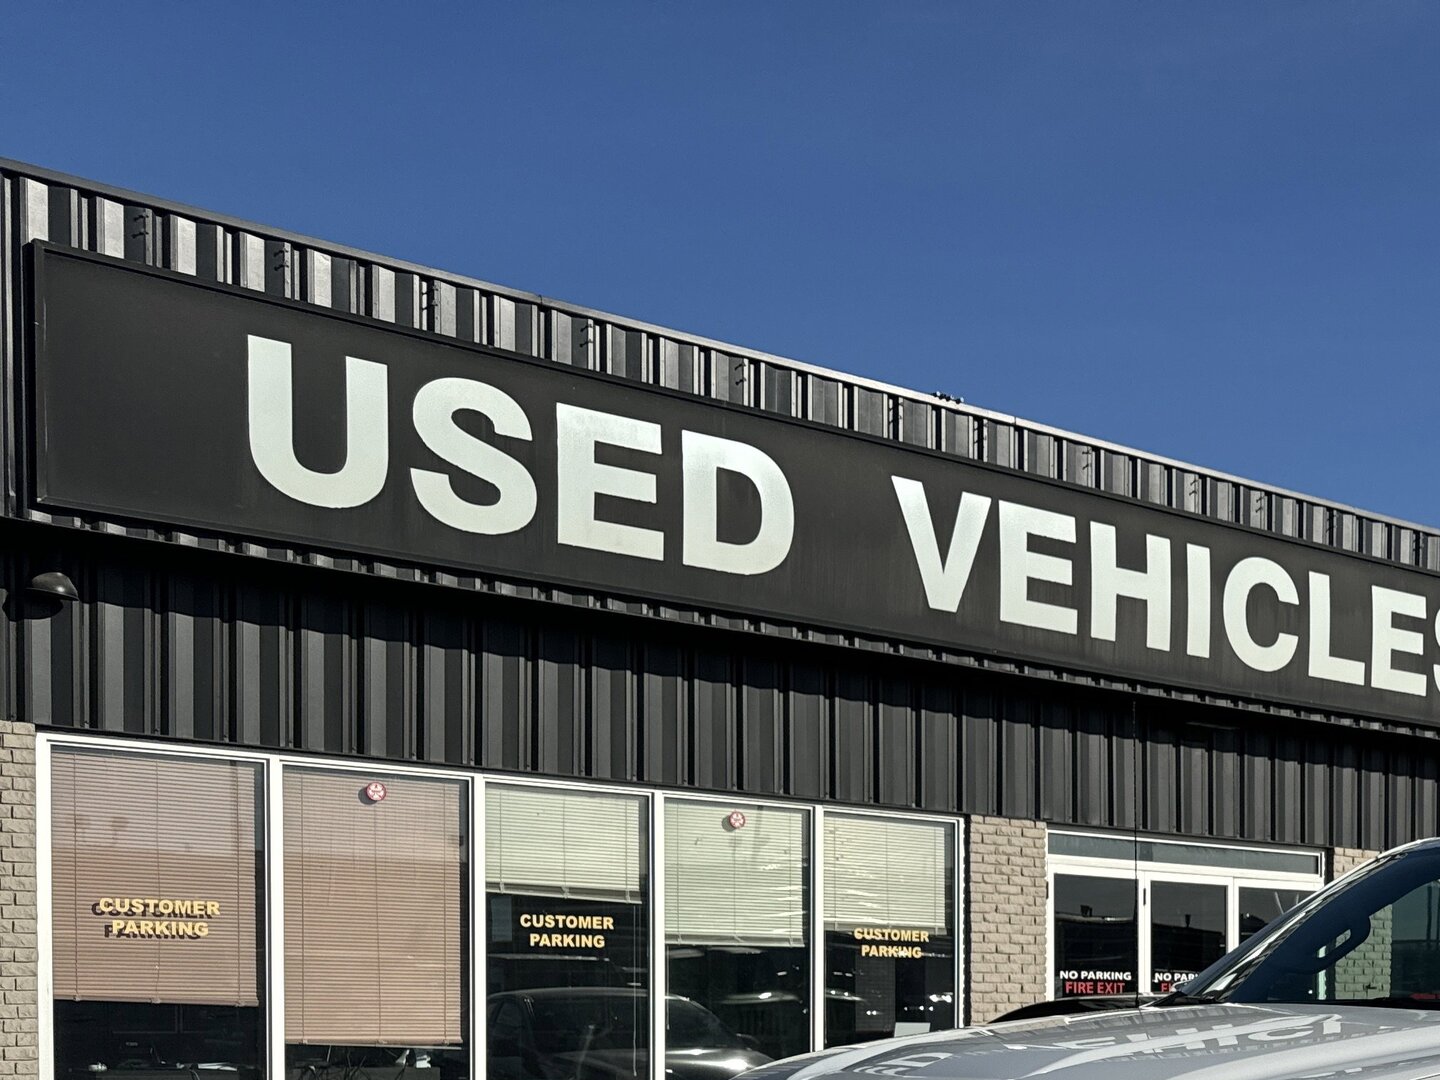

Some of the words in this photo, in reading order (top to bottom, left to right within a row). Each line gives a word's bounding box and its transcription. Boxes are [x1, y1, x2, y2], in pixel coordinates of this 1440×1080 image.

[247, 334, 795, 576] USED
[99, 897, 220, 915] CUSTOMER
[112, 919, 209, 937] PARKING
[520, 914, 615, 930] CUSTOMER
[529, 933, 606, 948] PARKING
[853, 927, 930, 943] CUSTOMER
[861, 944, 922, 959] PARKING
[1059, 970, 1079, 980] NO
[1082, 971, 1132, 981] PARKING
[1154, 972, 1172, 982] NO
[1174, 973, 1198, 982] PAR
[1065, 981, 1094, 994] FIRE
[1097, 982, 1125, 994] EXIT
